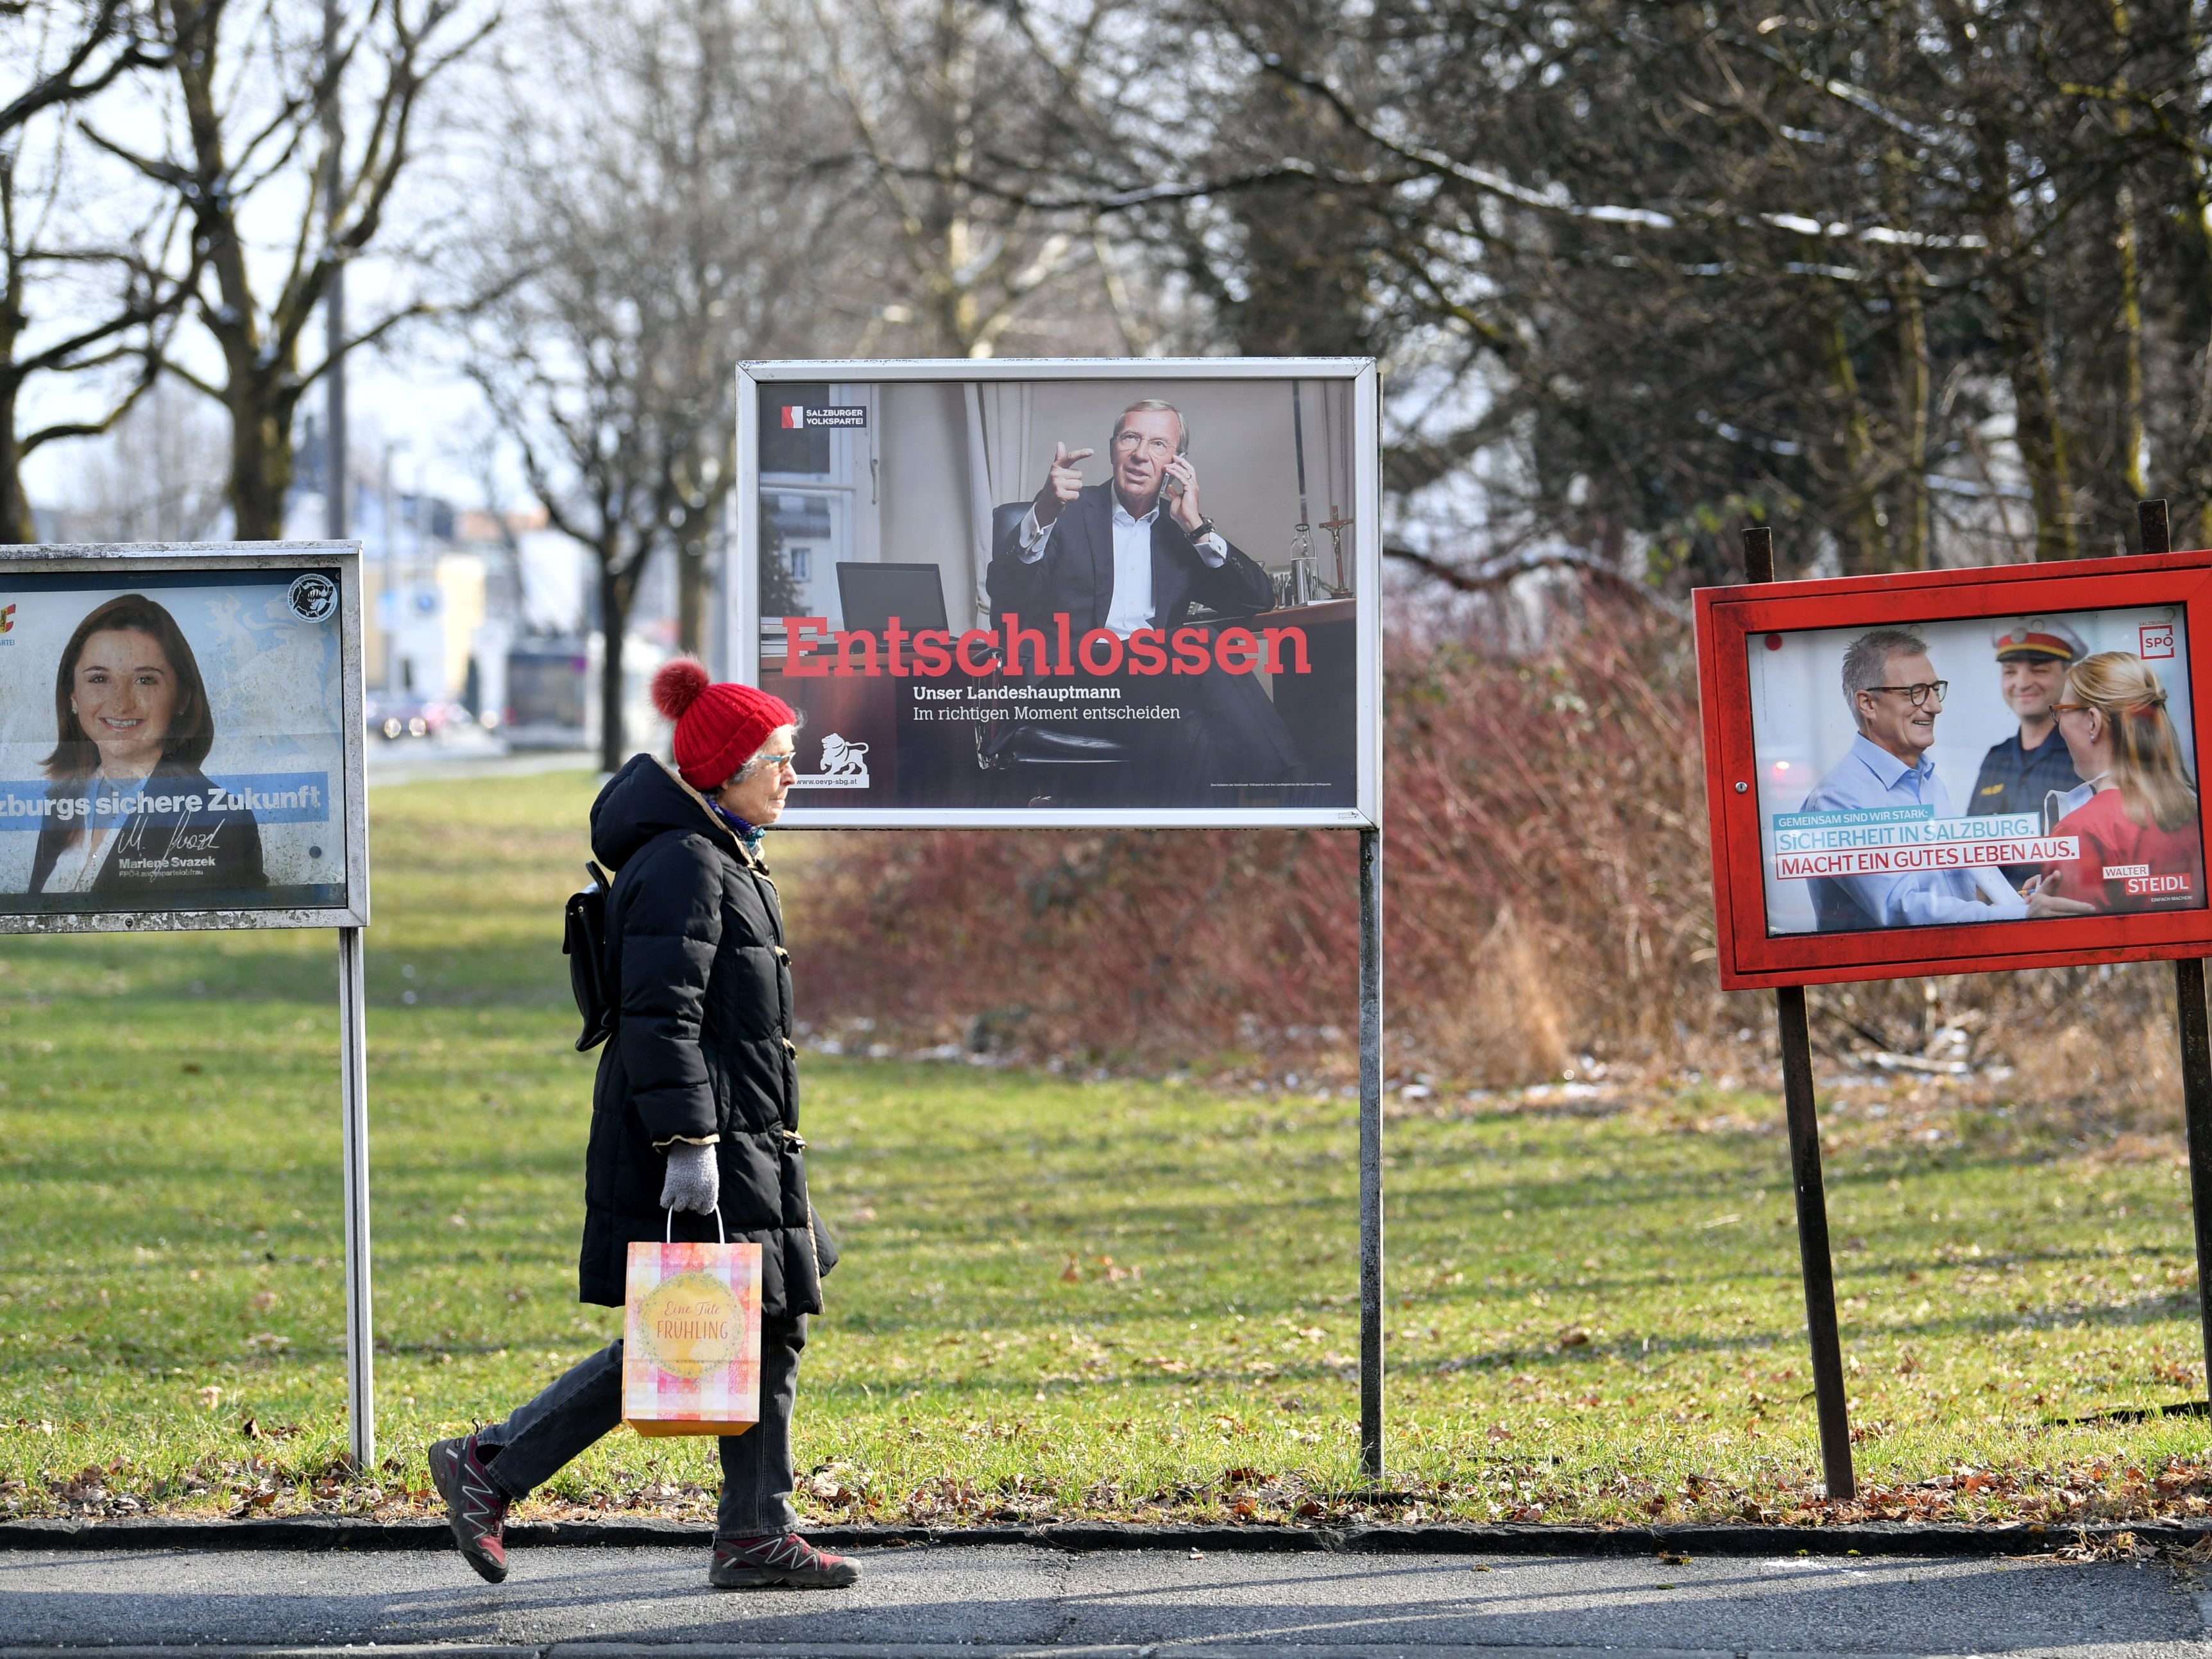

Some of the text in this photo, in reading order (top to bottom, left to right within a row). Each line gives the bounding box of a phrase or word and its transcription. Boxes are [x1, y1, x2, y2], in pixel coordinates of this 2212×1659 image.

[782, 613, 1312, 677] Entschlossen
[2145, 634, 2174, 648] SPÖ
[913, 685, 1121, 702] Unser Landeshauptmann
[913, 705, 1180, 723] Im richtigen Moment entscheiden
[96, 790, 203, 815] sichere
[207, 785, 321, 811] Zukunft
[1778, 809, 1928, 828] GEMEINSAM SIND WIR STARK:
[1779, 819, 2035, 851] SICHERHEIT IN SALZBURG.
[119, 856, 216, 869] Marlene Svazek
[1782, 840, 2075, 875] MACHT EIN GUTES LEBEN AUS.
[2106, 866, 2147, 877] WALTER
[2128, 876, 2189, 892] STEIDL
[665, 1300, 720, 1316] Eine Tüte
[657, 1317, 727, 1339] FRÜHLING
